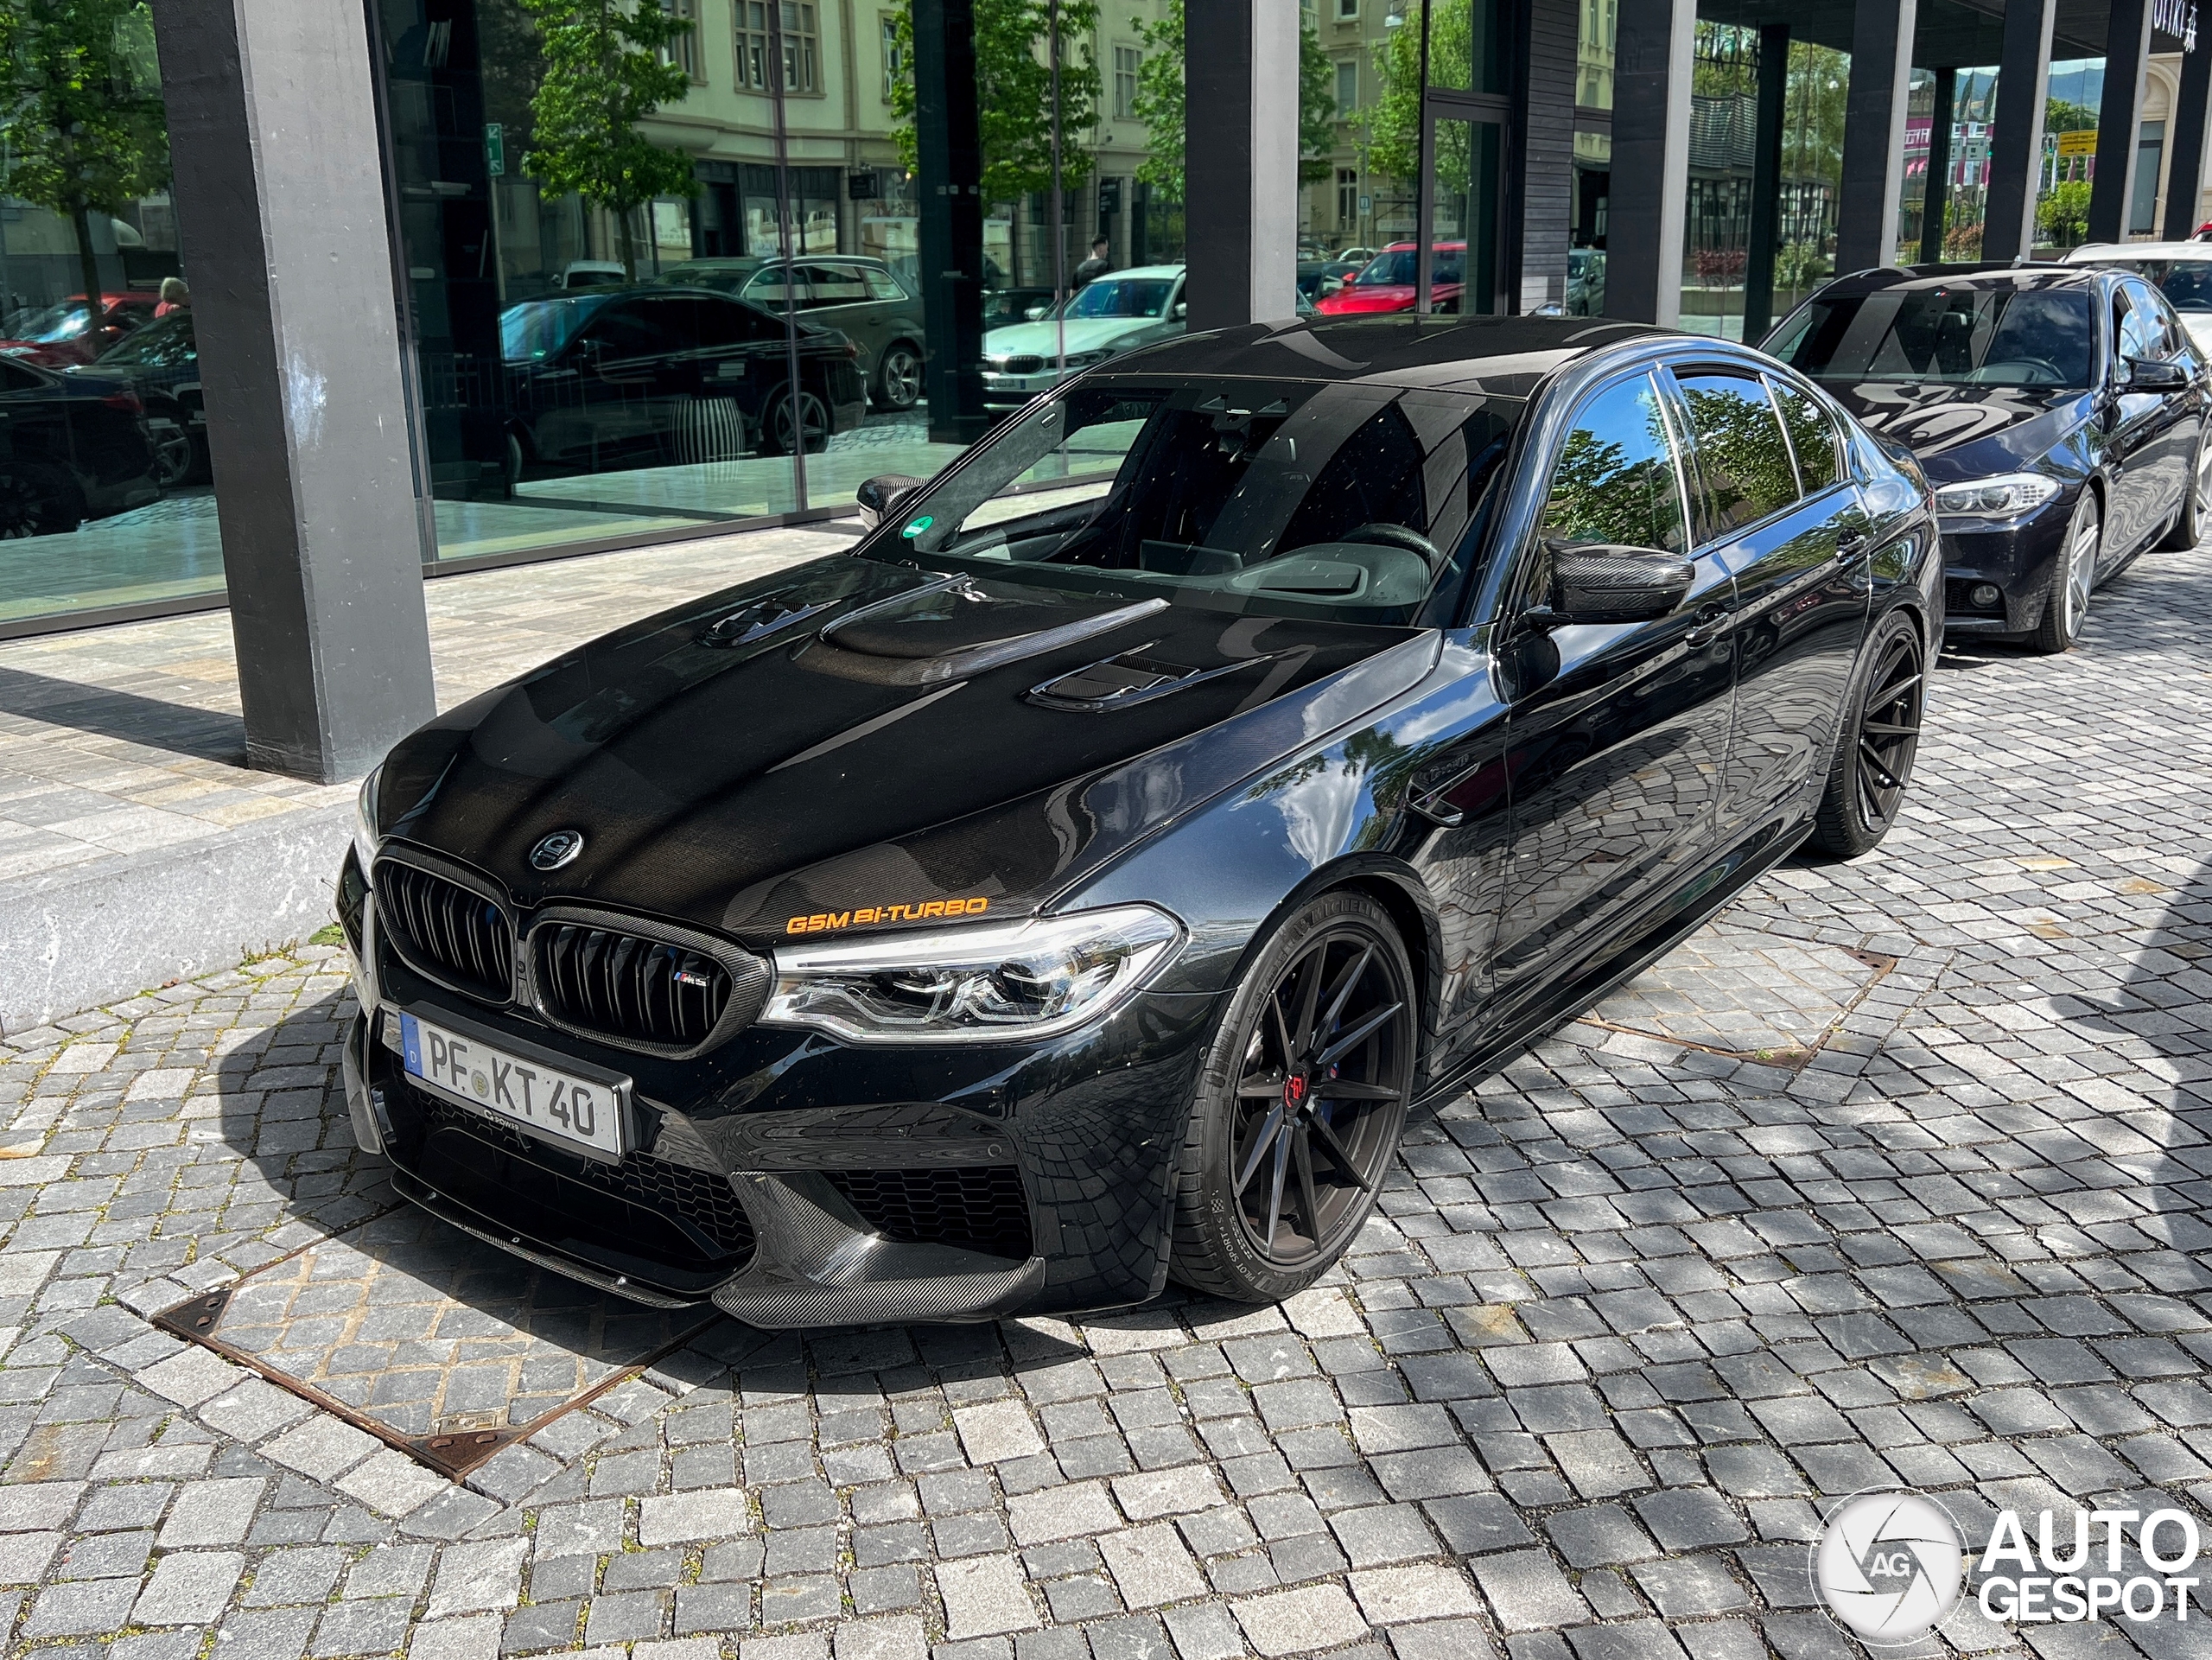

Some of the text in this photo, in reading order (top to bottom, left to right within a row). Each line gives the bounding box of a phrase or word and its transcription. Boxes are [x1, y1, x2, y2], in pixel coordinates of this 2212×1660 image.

[786, 912, 849, 934] G5M
[410, 1050, 417, 1064] D
[428, 1031, 595, 1137] PF KT 40
[1220, 1232, 1240, 1262] SPORT
[1236, 1262, 1255, 1282] PILOT
